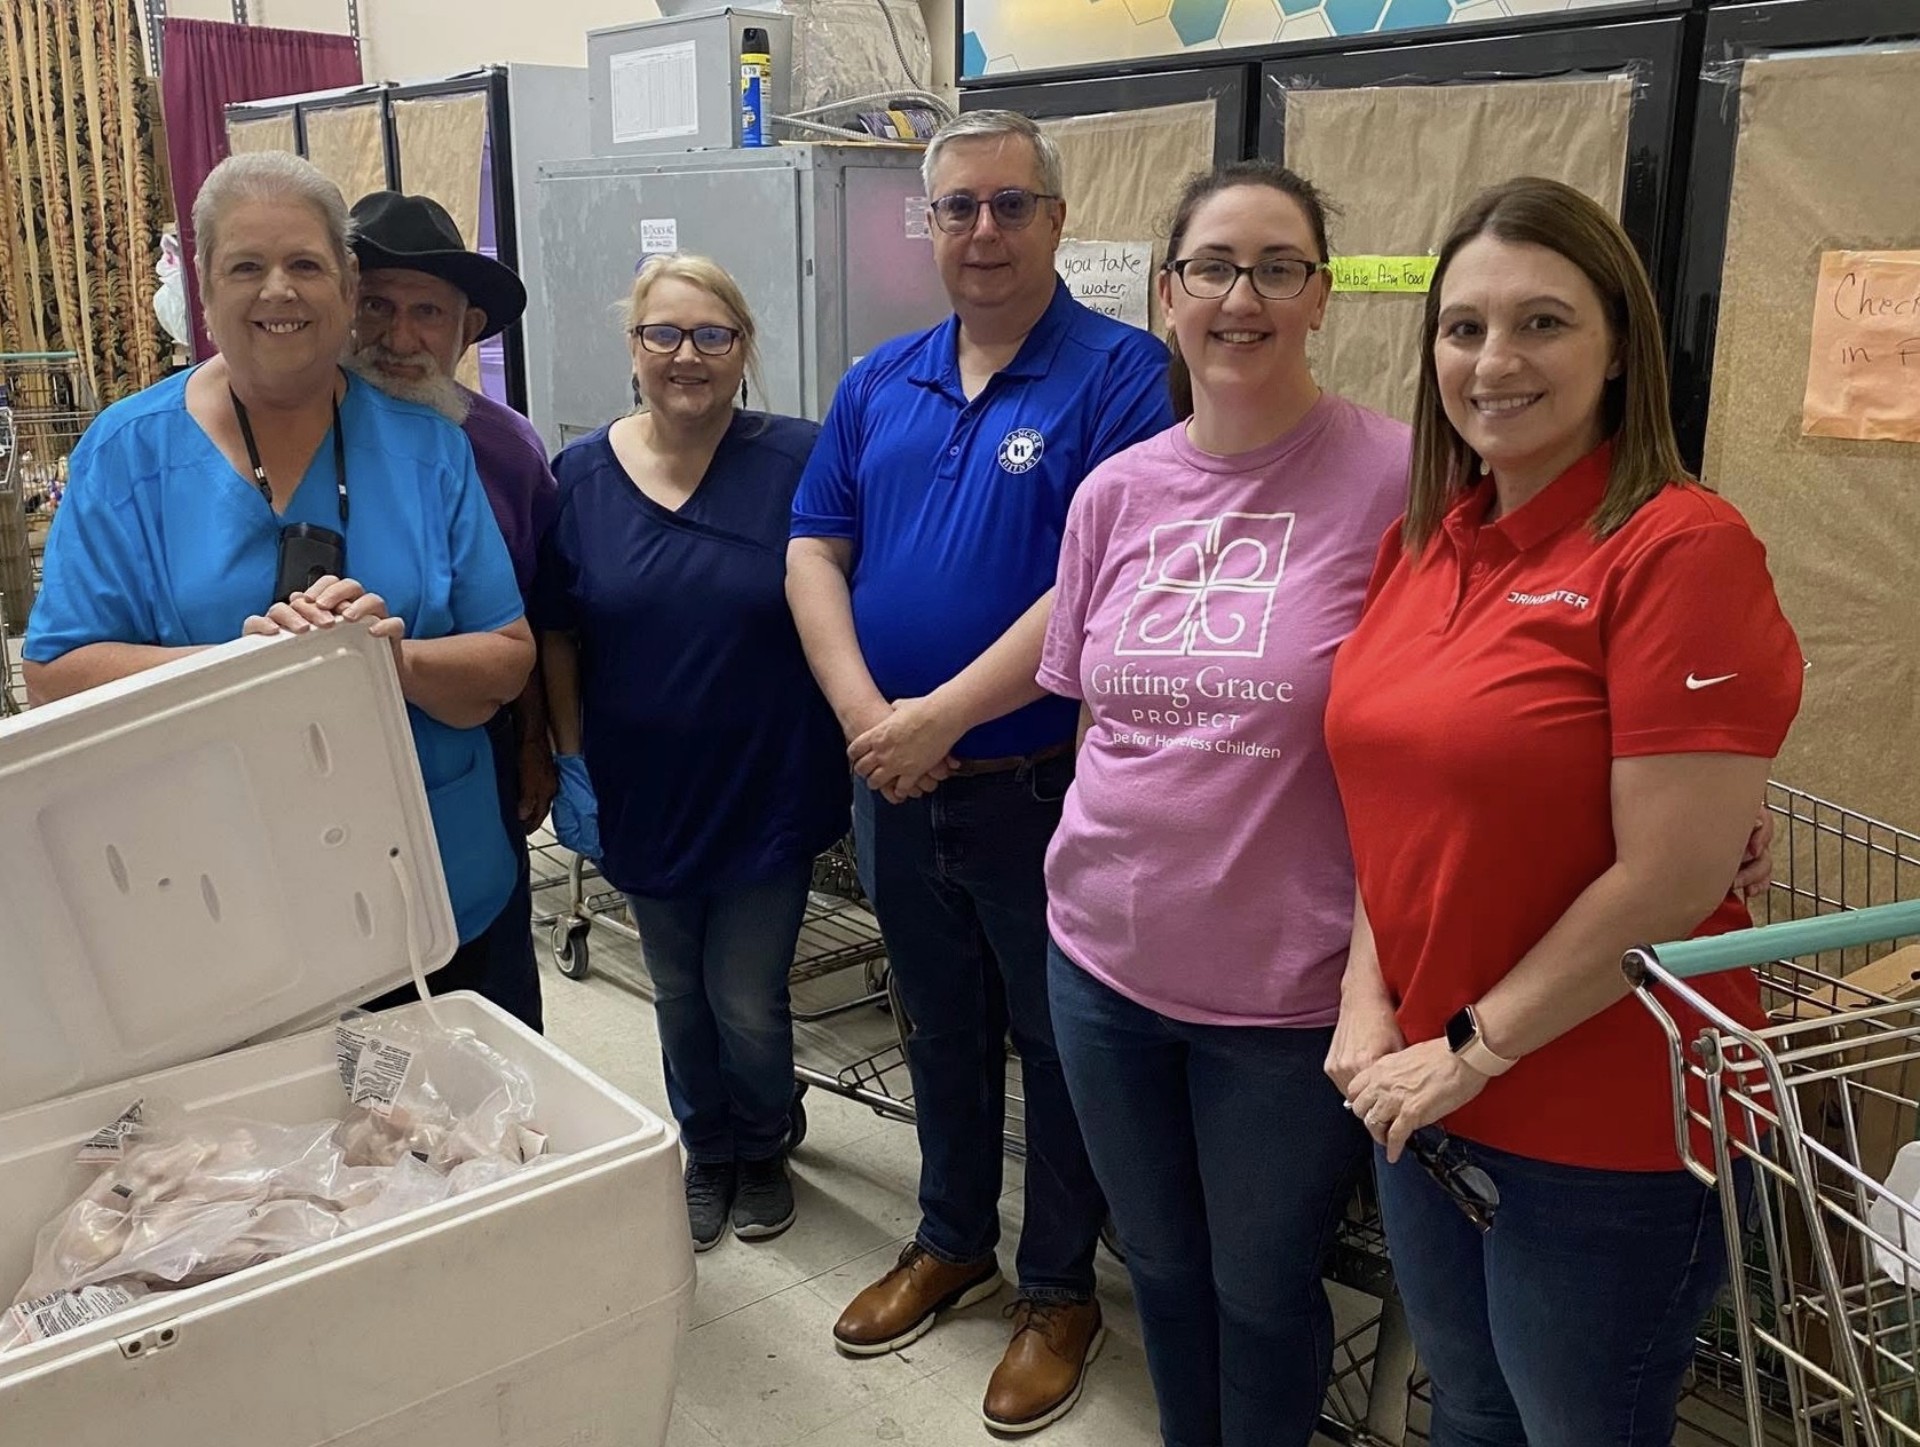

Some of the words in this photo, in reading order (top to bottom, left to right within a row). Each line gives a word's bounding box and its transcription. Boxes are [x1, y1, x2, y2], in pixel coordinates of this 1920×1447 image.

[1065, 258, 1091, 281] you
[1099, 248, 1141, 275] take
[1402, 262, 1425, 285] Food
[1841, 346, 1871, 365] in
[1004, 430, 1042, 449] HANCOCK
[1000, 452, 1037, 472] WHITNEY
[1091, 663, 1190, 709] Gifting
[1196, 665, 1294, 703] Grace
[1132, 709, 1241, 730] PROJECT
[1113, 731, 1130, 745] pe
[1132, 731, 1151, 746] for
[1215, 740, 1281, 759] Children
